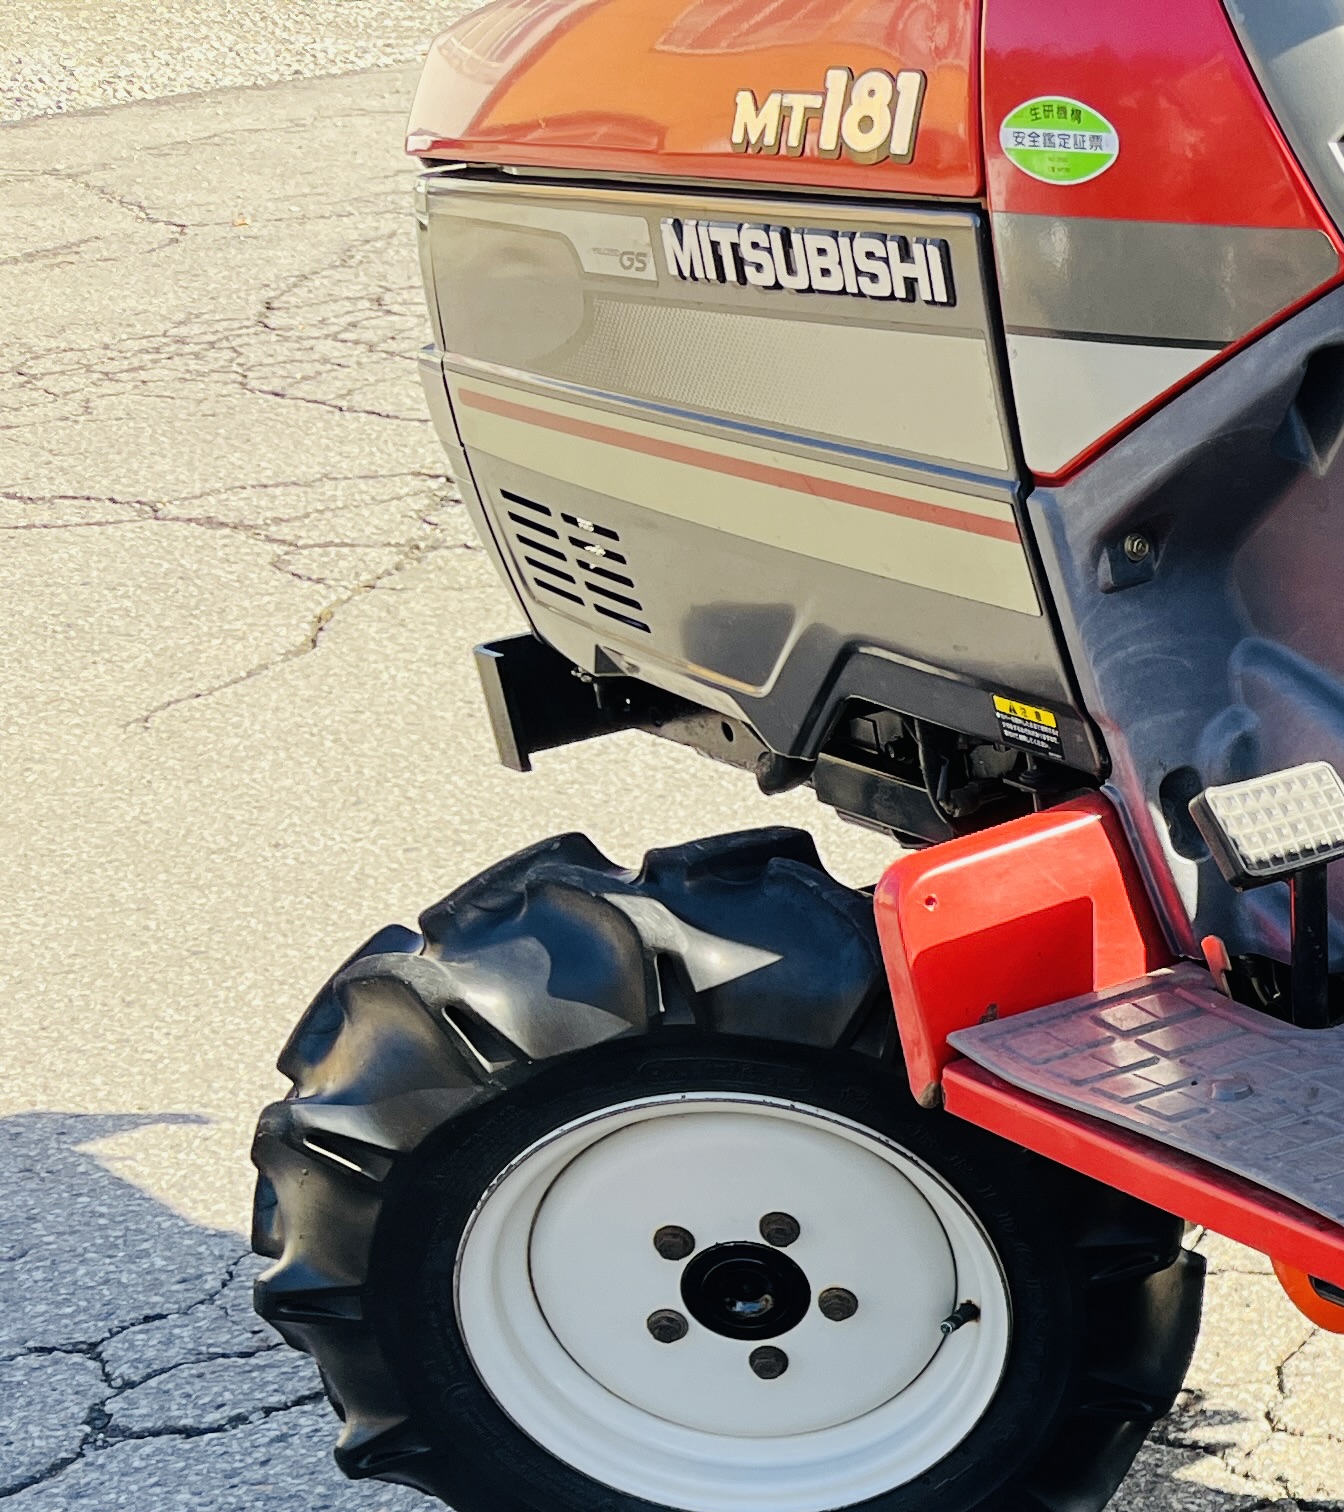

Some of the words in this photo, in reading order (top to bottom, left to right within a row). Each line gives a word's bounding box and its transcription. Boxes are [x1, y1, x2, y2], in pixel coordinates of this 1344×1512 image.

[731, 66, 926, 163] MT181
[1012, 131, 1103, 151] 安全鑑定証票
[620, 251, 647, 272] GS
[660, 217, 955, 306] MITSUBISHI
